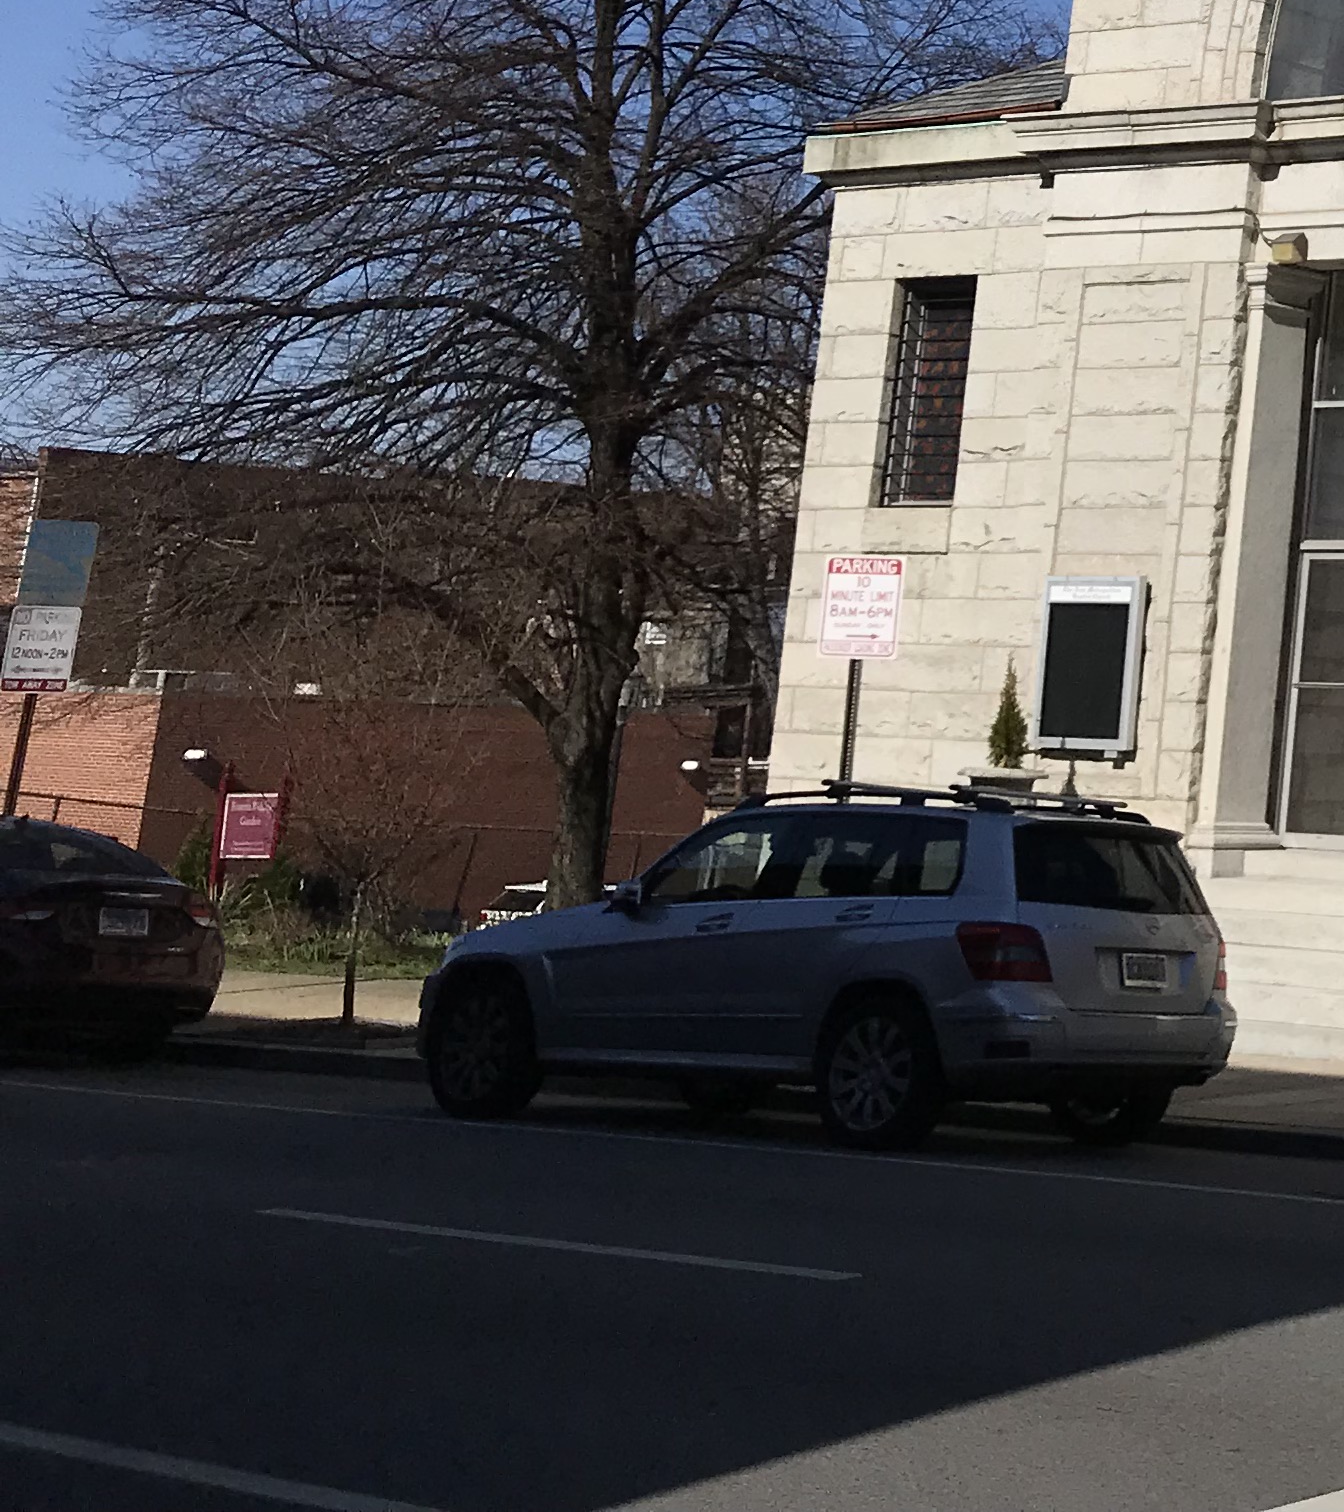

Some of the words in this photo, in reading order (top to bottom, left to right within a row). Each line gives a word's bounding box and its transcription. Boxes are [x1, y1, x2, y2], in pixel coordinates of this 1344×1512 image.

[832, 558, 898, 574] PARKING
[857, 576, 871, 588] 10
[830, 590, 865, 603] MINUTE
[870, 591, 894, 602] LIMIT
[830, 604, 893, 618] 8AM-6PM
[19, 629, 67, 641] FRIDAY
